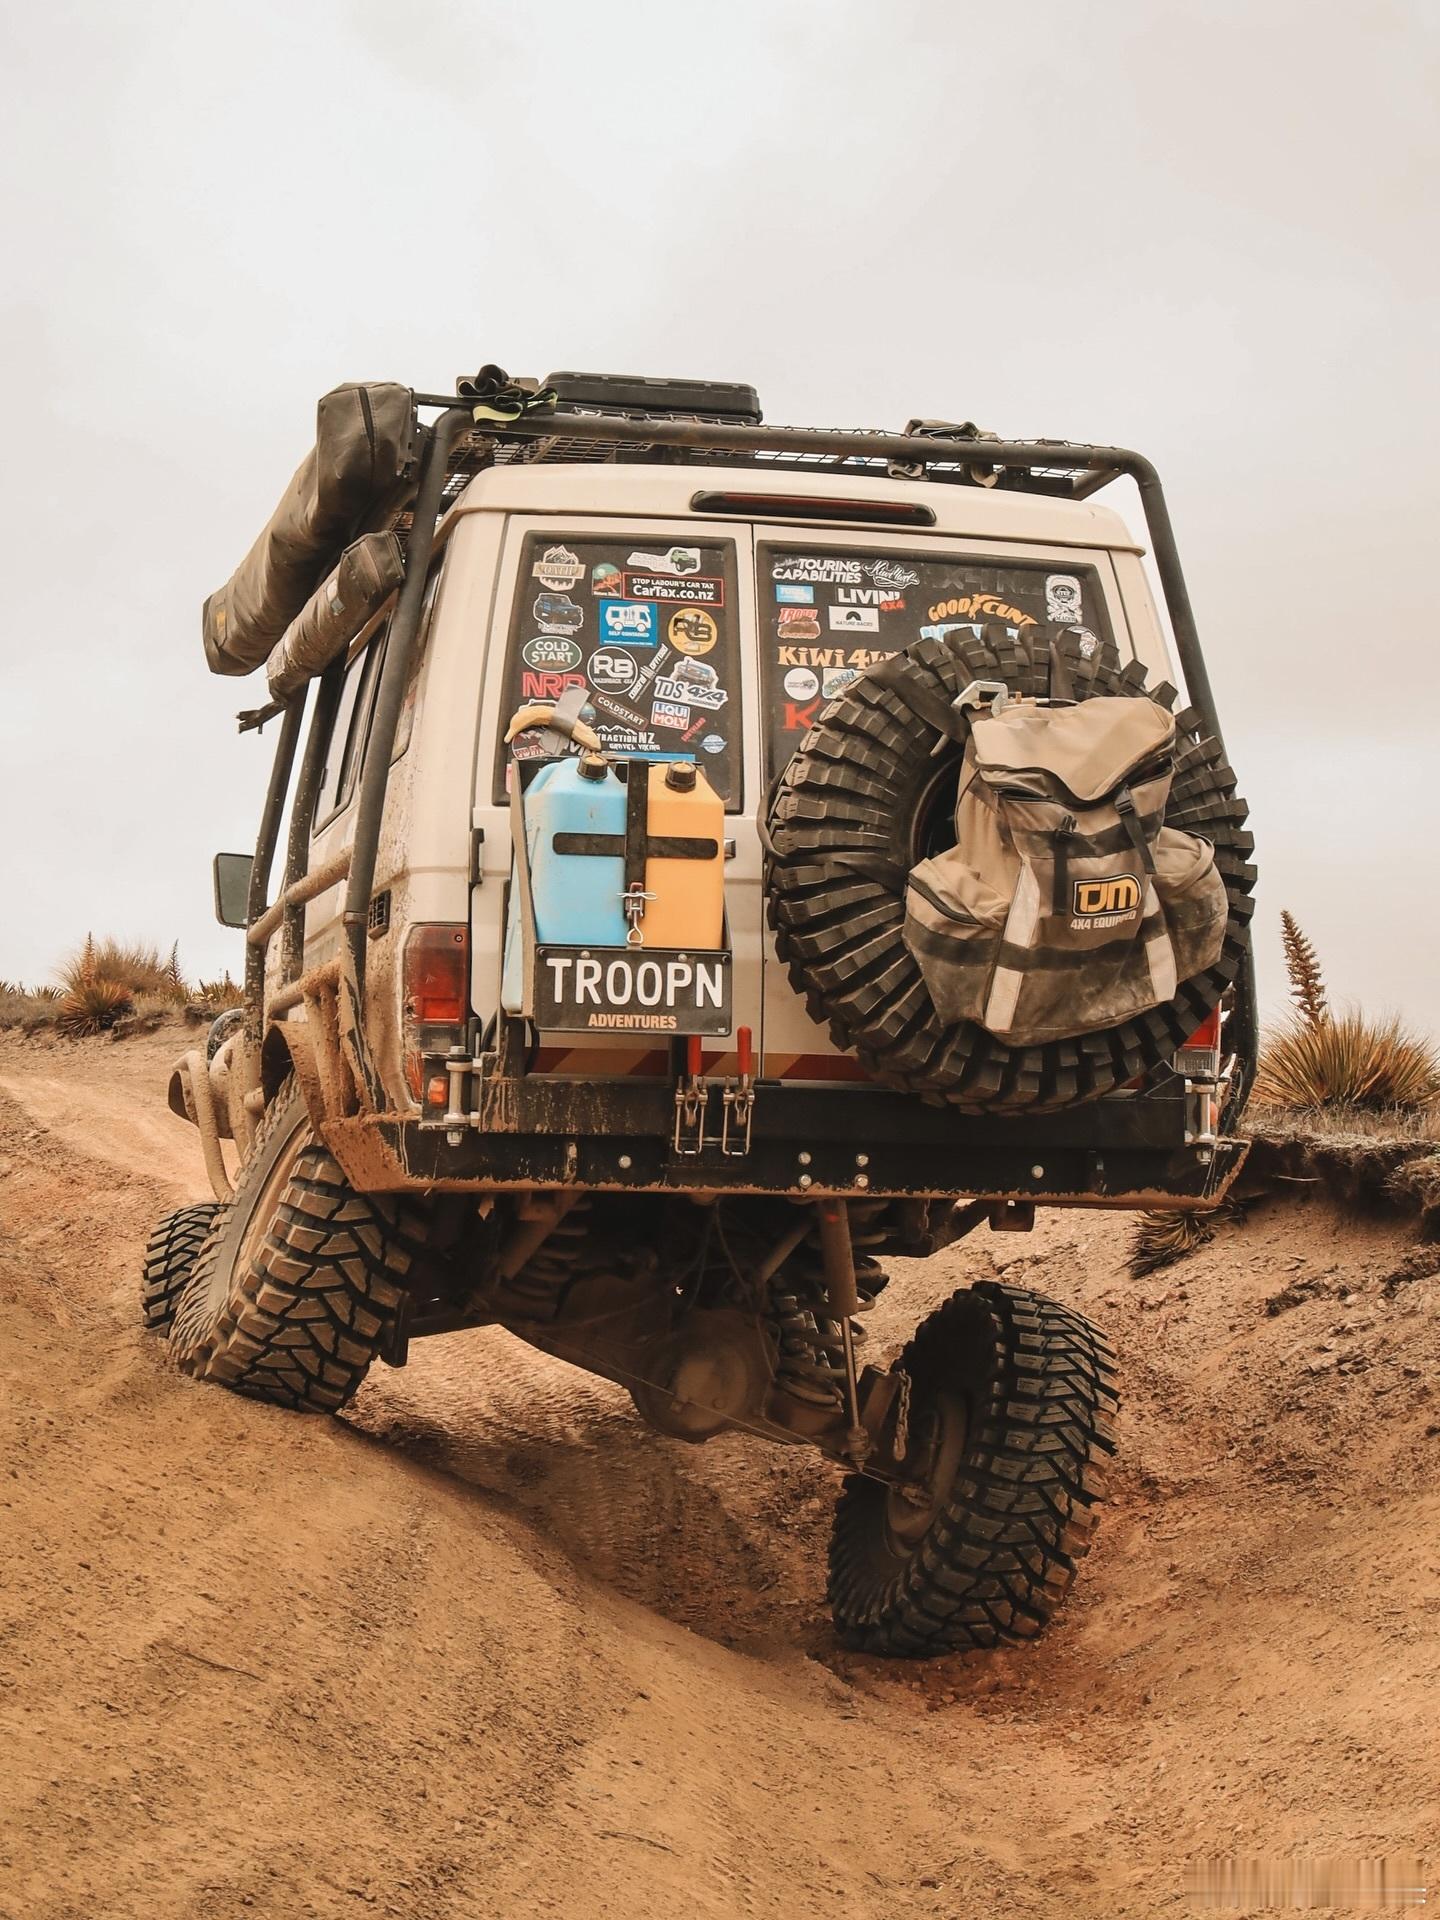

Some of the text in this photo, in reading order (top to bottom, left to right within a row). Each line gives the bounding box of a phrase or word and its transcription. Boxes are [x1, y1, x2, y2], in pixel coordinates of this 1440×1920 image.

[798, 558, 861, 573] TOURING
[651, 579, 685, 588] LABOUR'S
[772, 568, 862, 584] CAPABILITIES
[633, 585, 714, 600] CarTax.co.nz
[928, 597, 971, 622] GOOD
[535, 641, 570, 651] COLD
[531, 651, 573, 663] START
[593, 655, 634, 678] RB
[656, 678, 685, 699] TDS
[597, 697, 645, 726] COLDSTART
[655, 703, 688, 718] LIQUI
[654, 713, 687, 728] MOLY
[638, 731, 655, 744] NZ
[546, 957, 723, 1008] TROOPN
[588, 1013, 677, 1030] ADVENTURES
